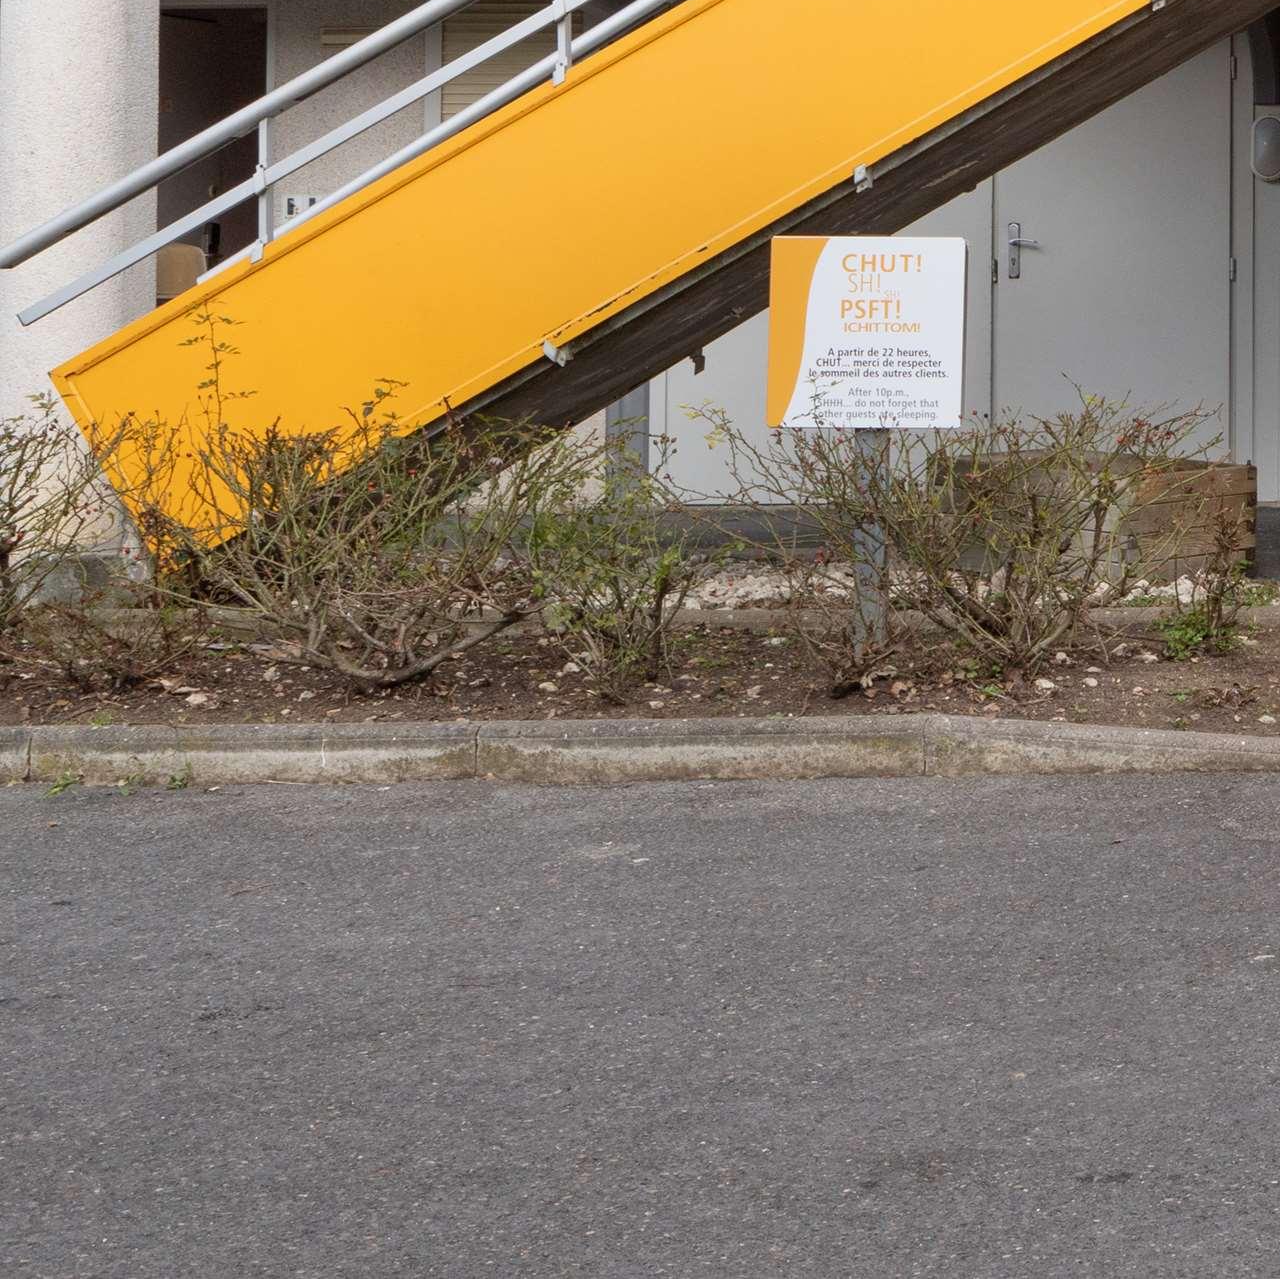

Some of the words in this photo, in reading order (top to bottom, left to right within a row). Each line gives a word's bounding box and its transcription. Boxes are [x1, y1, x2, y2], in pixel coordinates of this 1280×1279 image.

[842, 254, 922, 272] CHUT!
[848, 272, 881, 293] SH!
[840, 299, 900, 319] PSFT!
[827, 348, 835, 357] A
[837, 348, 864, 358] partir
[867, 348, 879, 357] de
[882, 348, 894, 357] 22
[896, 347, 931, 358] heures,
[853, 358, 880, 367] merci
[882, 358, 895, 367] de
[897, 358, 942, 369] respecter
[809, 368, 817, 377] le
[820, 368, 860, 378] sommeil
[863, 368, 879, 378] des
[882, 369, 912, 378] autres
[915, 368, 949, 378] clients.
[848, 387, 872, 397] After
[854, 399, 867, 408] do
[869, 400, 885, 408] not
[887, 399, 917, 410] forget
[919, 399, 939, 408] that
[818, 410, 844, 418] other
[846, 410, 876, 420] guests
